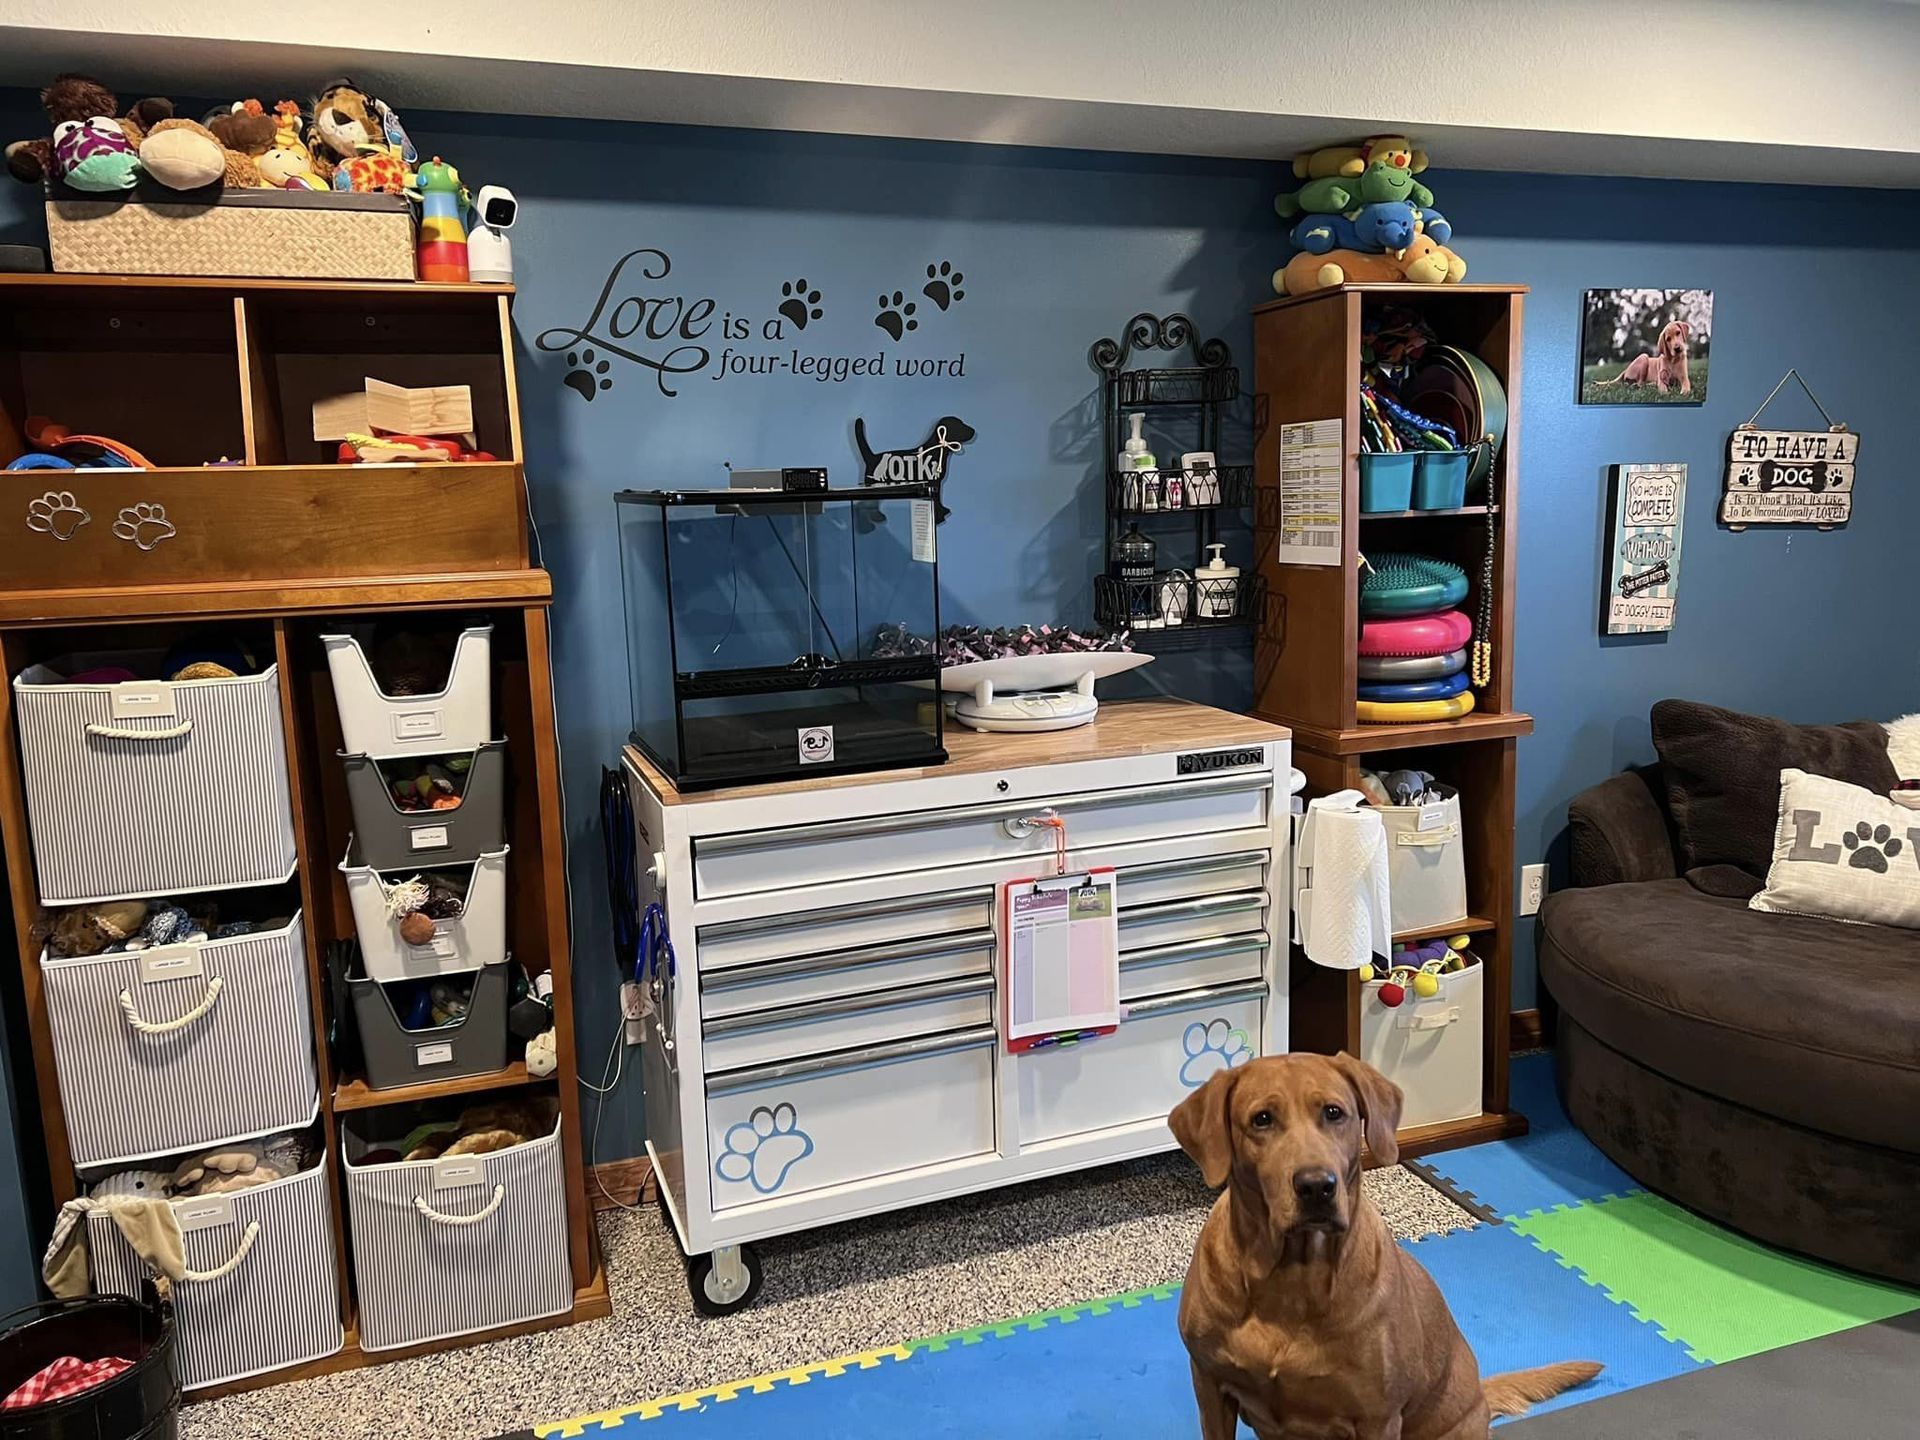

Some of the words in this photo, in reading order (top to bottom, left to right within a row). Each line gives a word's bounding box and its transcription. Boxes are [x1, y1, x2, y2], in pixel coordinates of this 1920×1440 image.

[536, 249, 716, 398] Love
[723, 312, 750, 340] is
[763, 318, 785, 340] a
[712, 348, 885, 382] four-legged
[896, 353, 966, 377] word
[1743, 436, 1768, 458] TO
[1774, 437, 1828, 460] HAVE
[1833, 438, 1846, 460] A
[1771, 468, 1813, 485] DOG
[1644, 485, 1663, 496] HOME
[1665, 485, 1672, 496] IS
[1632, 499, 1672, 516] COMPLETE
[1746, 494, 1757, 505] To
[1626, 540, 1671, 560] WITHOUT
[1200, 751, 1261, 768] YUKON
